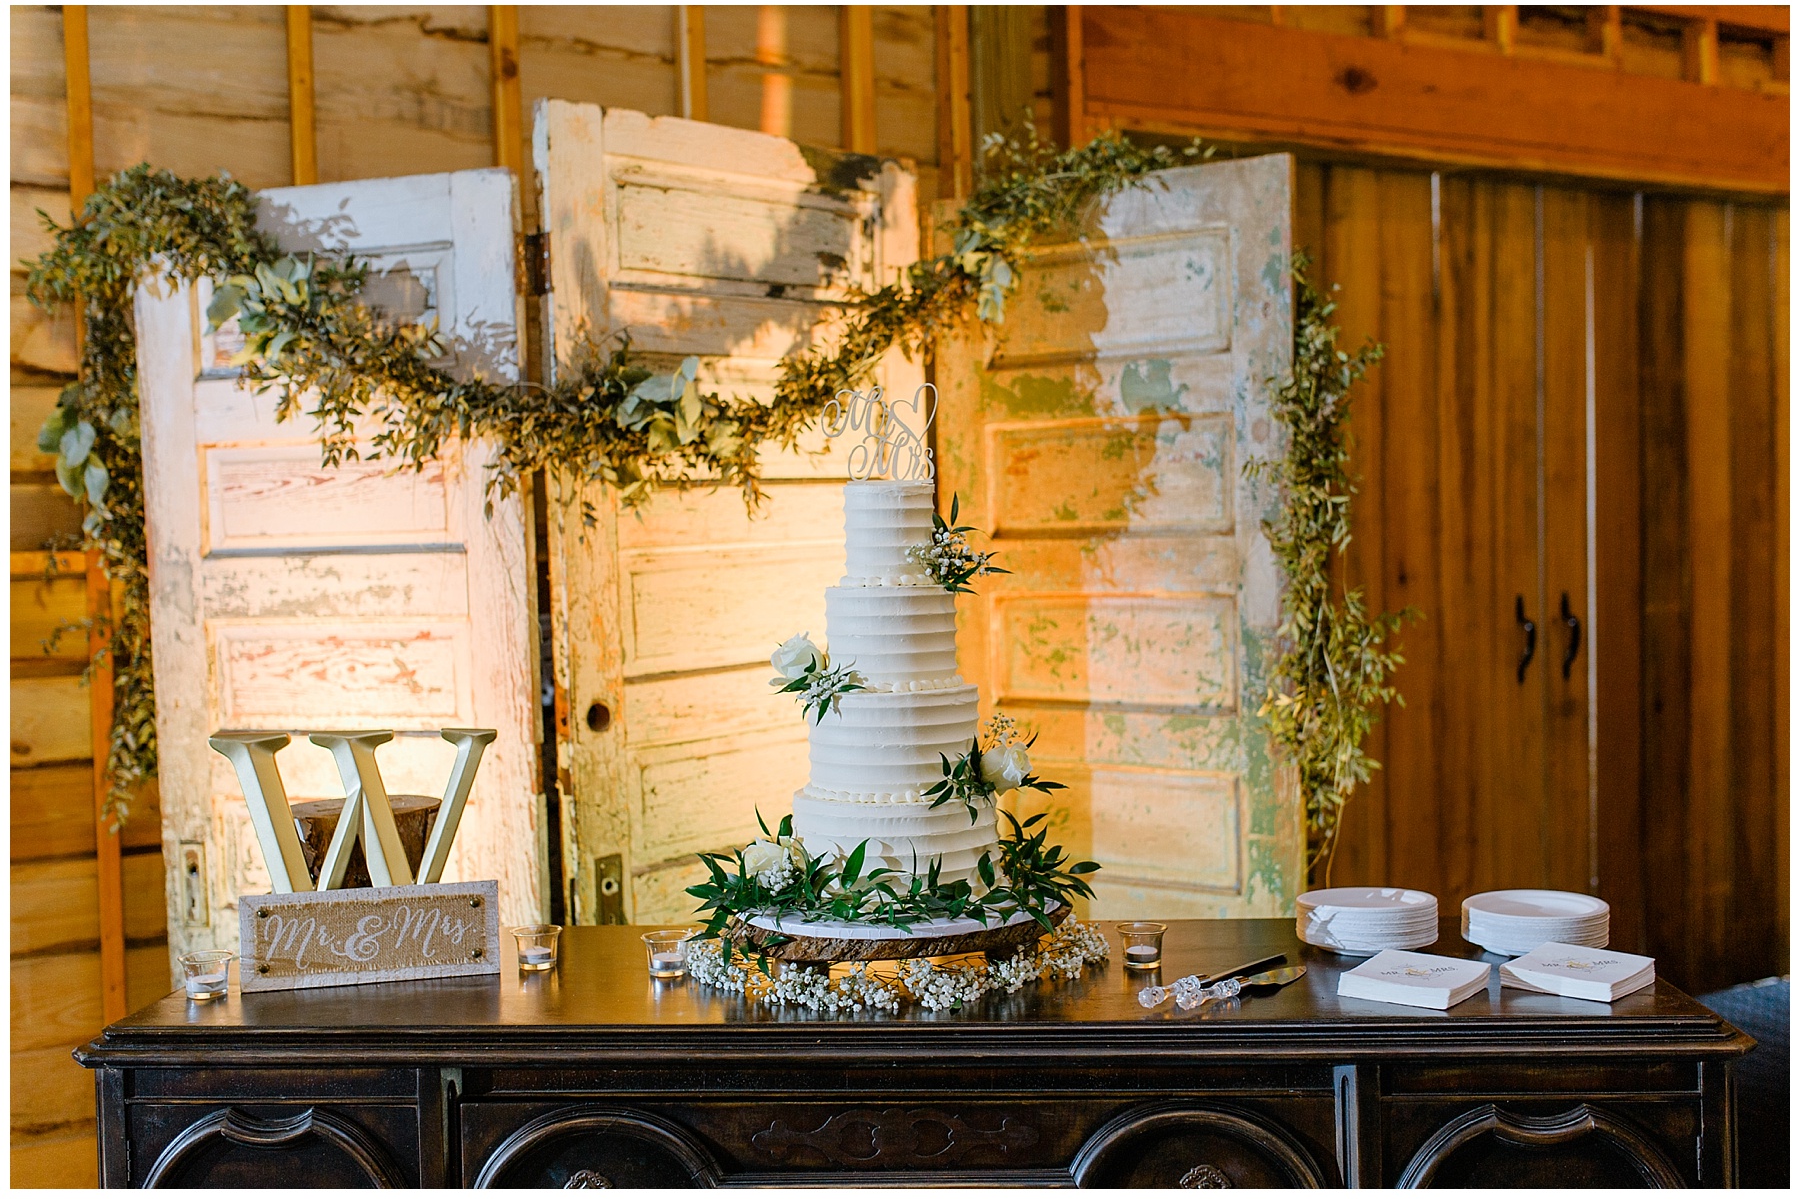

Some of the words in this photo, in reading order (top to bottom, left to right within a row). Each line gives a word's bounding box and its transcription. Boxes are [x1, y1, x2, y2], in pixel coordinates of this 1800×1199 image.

[848, 430, 936, 481] Mrs
[208, 728, 498, 894] W
[331, 915, 392, 962] &
[393, 905, 477, 958] Mrs.
